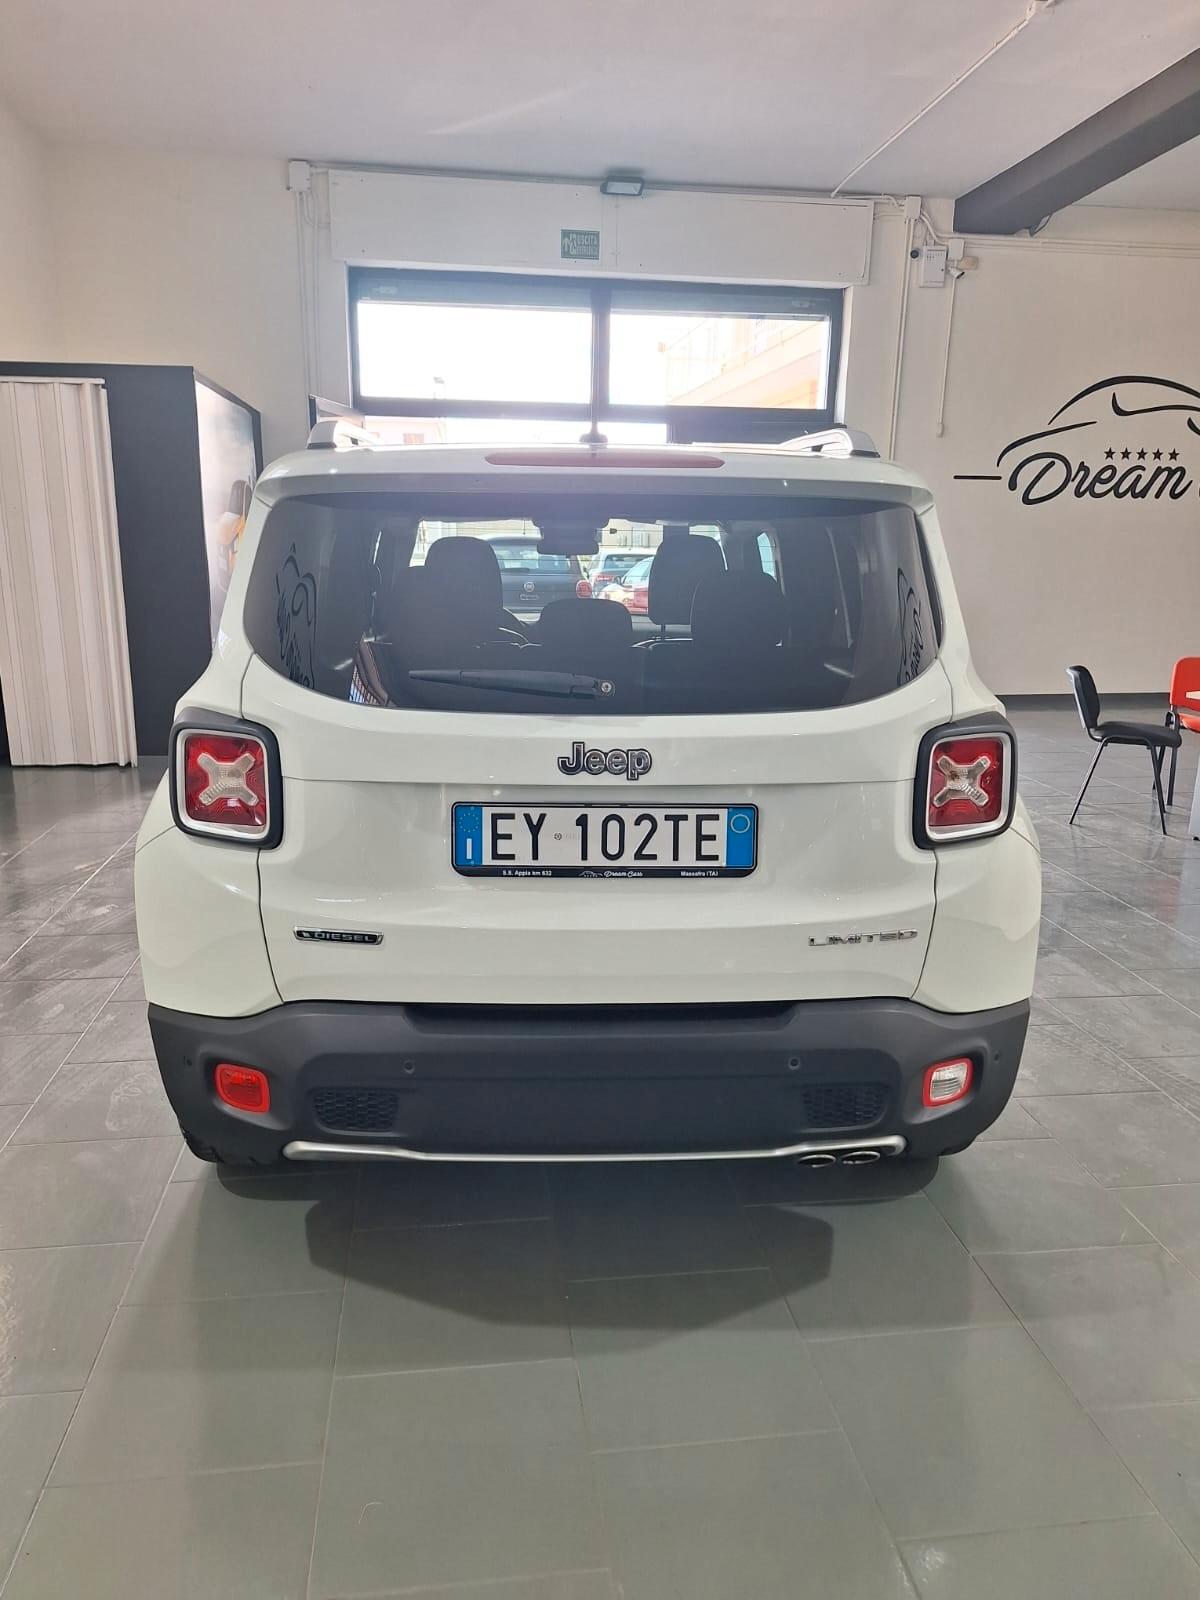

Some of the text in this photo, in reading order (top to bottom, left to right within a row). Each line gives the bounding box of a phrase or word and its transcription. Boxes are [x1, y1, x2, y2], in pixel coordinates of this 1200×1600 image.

[1008, 451, 1193, 506] Dream
[557, 741, 653, 781] Jeep
[490, 812, 720, 862] EY 102TE
[314, 931, 375, 942] DIESEL
[808, 928, 918, 947] LIMITED
